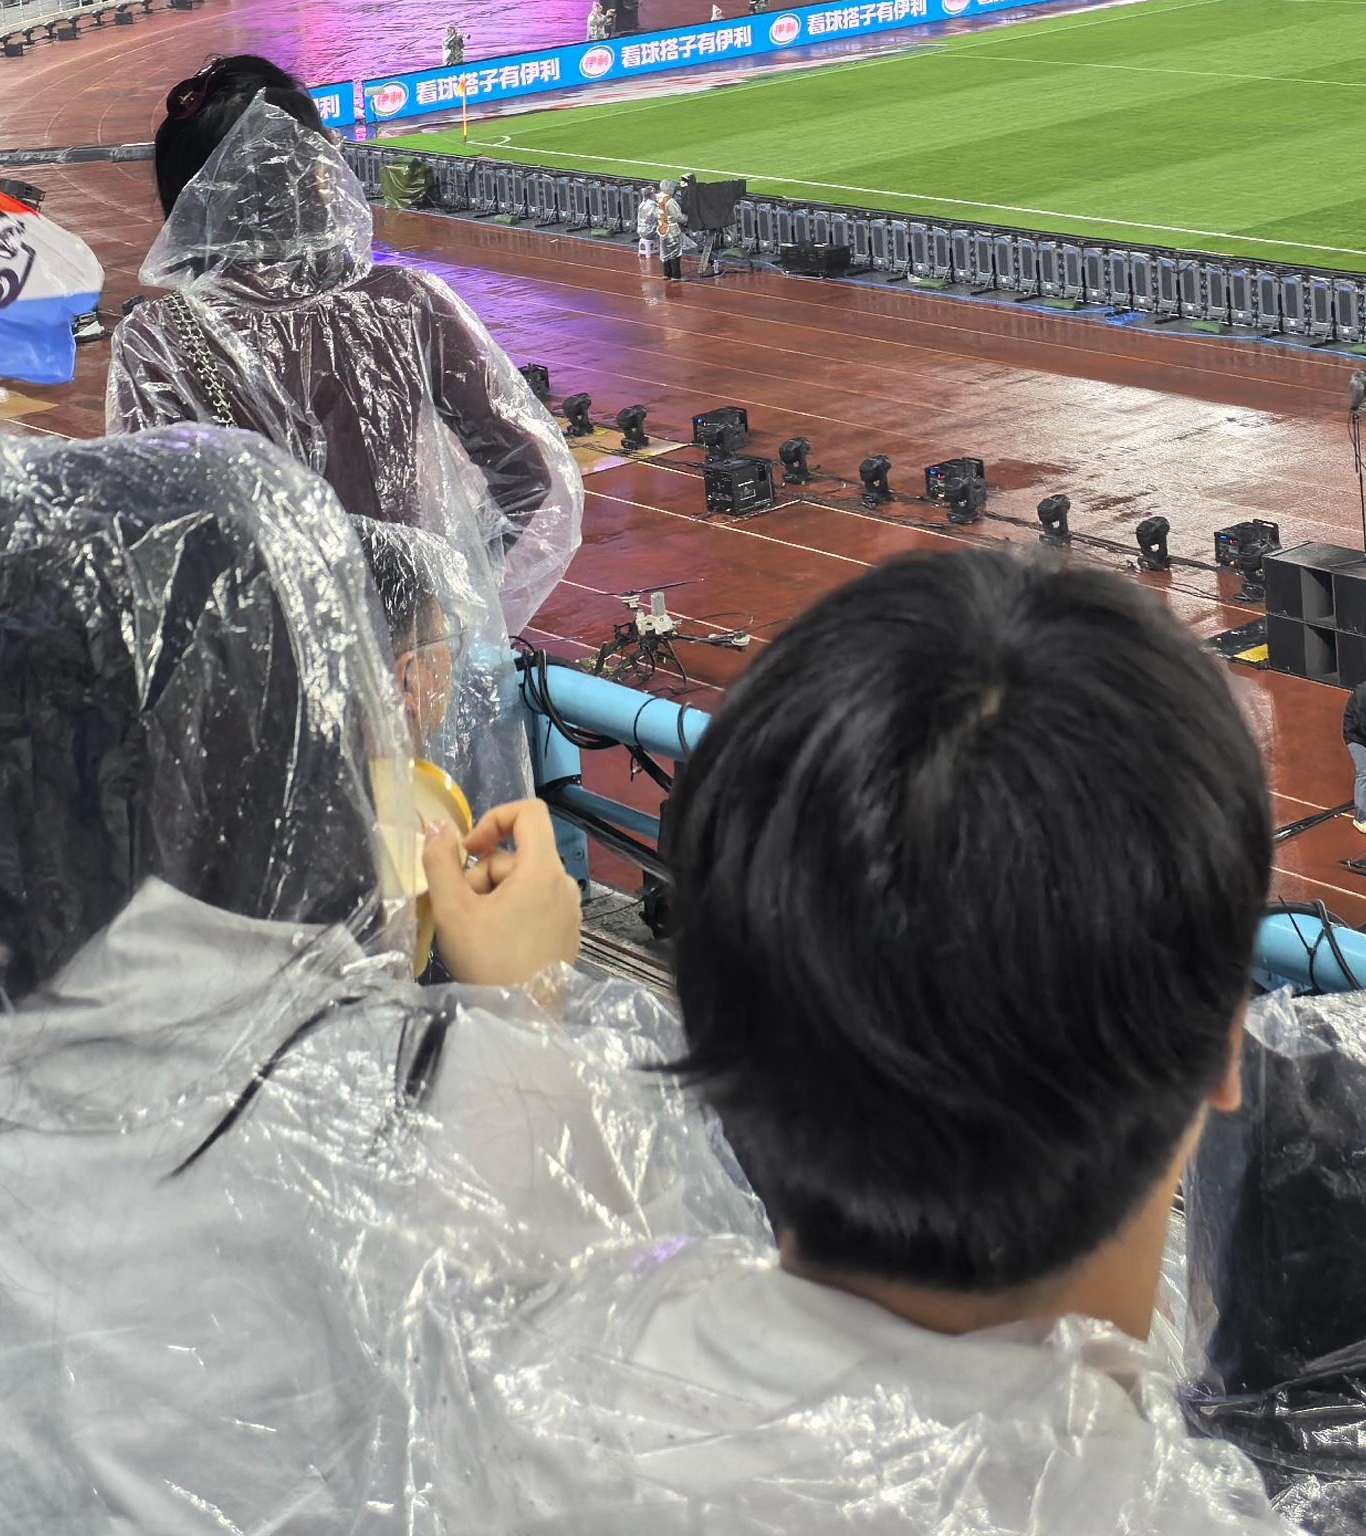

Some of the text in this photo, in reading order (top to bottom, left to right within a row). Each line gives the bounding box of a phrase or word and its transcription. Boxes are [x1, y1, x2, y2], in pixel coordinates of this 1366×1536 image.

[621, 26, 753, 69] 看球搭子有伊利
[416, 58, 561, 105] 看球搭子有伊利
